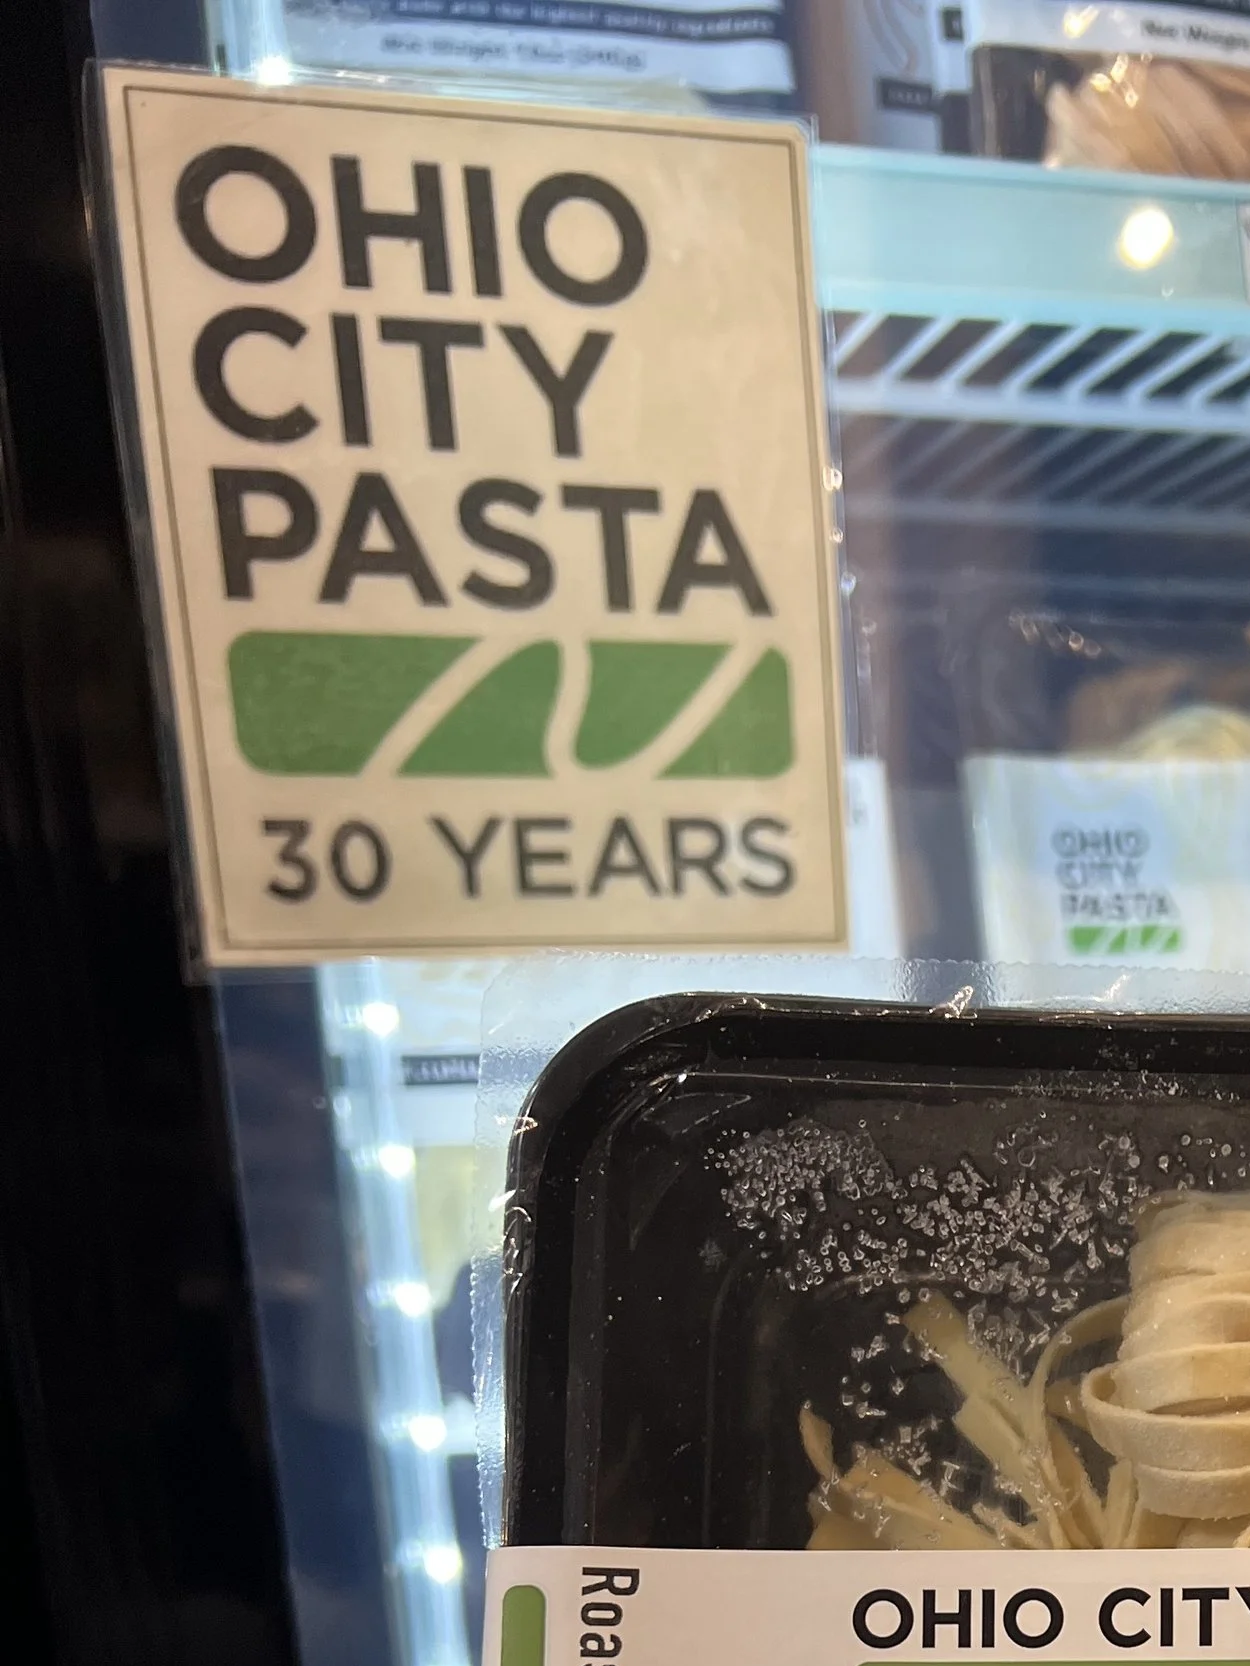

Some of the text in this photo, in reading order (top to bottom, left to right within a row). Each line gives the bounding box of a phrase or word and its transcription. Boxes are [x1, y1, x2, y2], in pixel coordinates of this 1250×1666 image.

[175, 144, 649, 306] OHIO
[192, 306, 615, 458] CITY
[210, 467, 776, 617] PASTA
[263, 816, 797, 904] 30 YEARS
[1052, 824, 1150, 859] OHIO
[1055, 860, 1142, 889] CITY
[1060, 891, 1179, 920] PASTA
[853, 1588, 1064, 1649] OHIO
